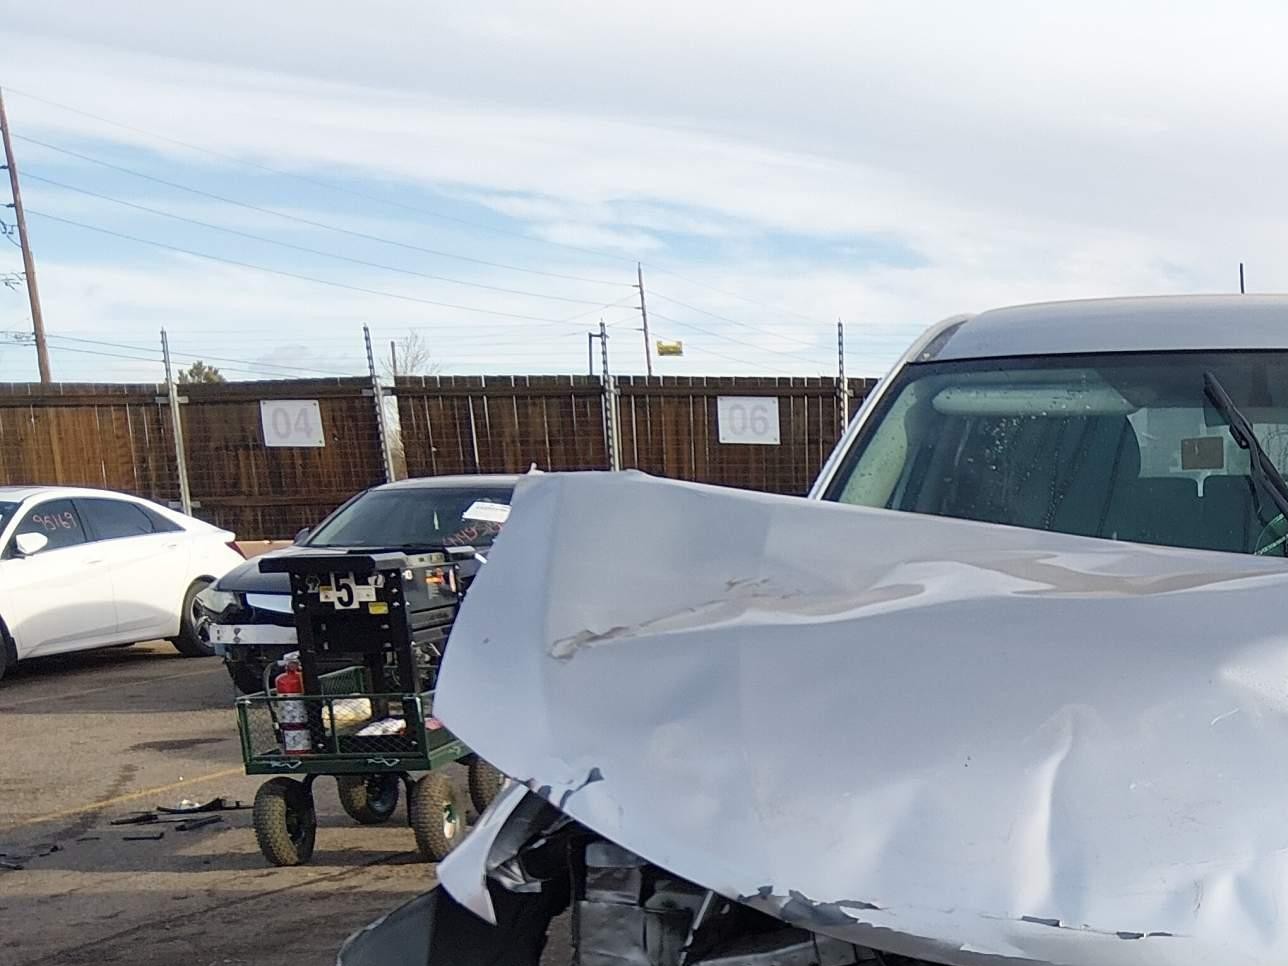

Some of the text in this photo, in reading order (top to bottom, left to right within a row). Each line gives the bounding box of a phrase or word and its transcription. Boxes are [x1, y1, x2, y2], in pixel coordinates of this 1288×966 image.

[272, 408, 311, 439] 04
[728, 403, 769, 436] 06
[334, 571, 354, 607] 5
